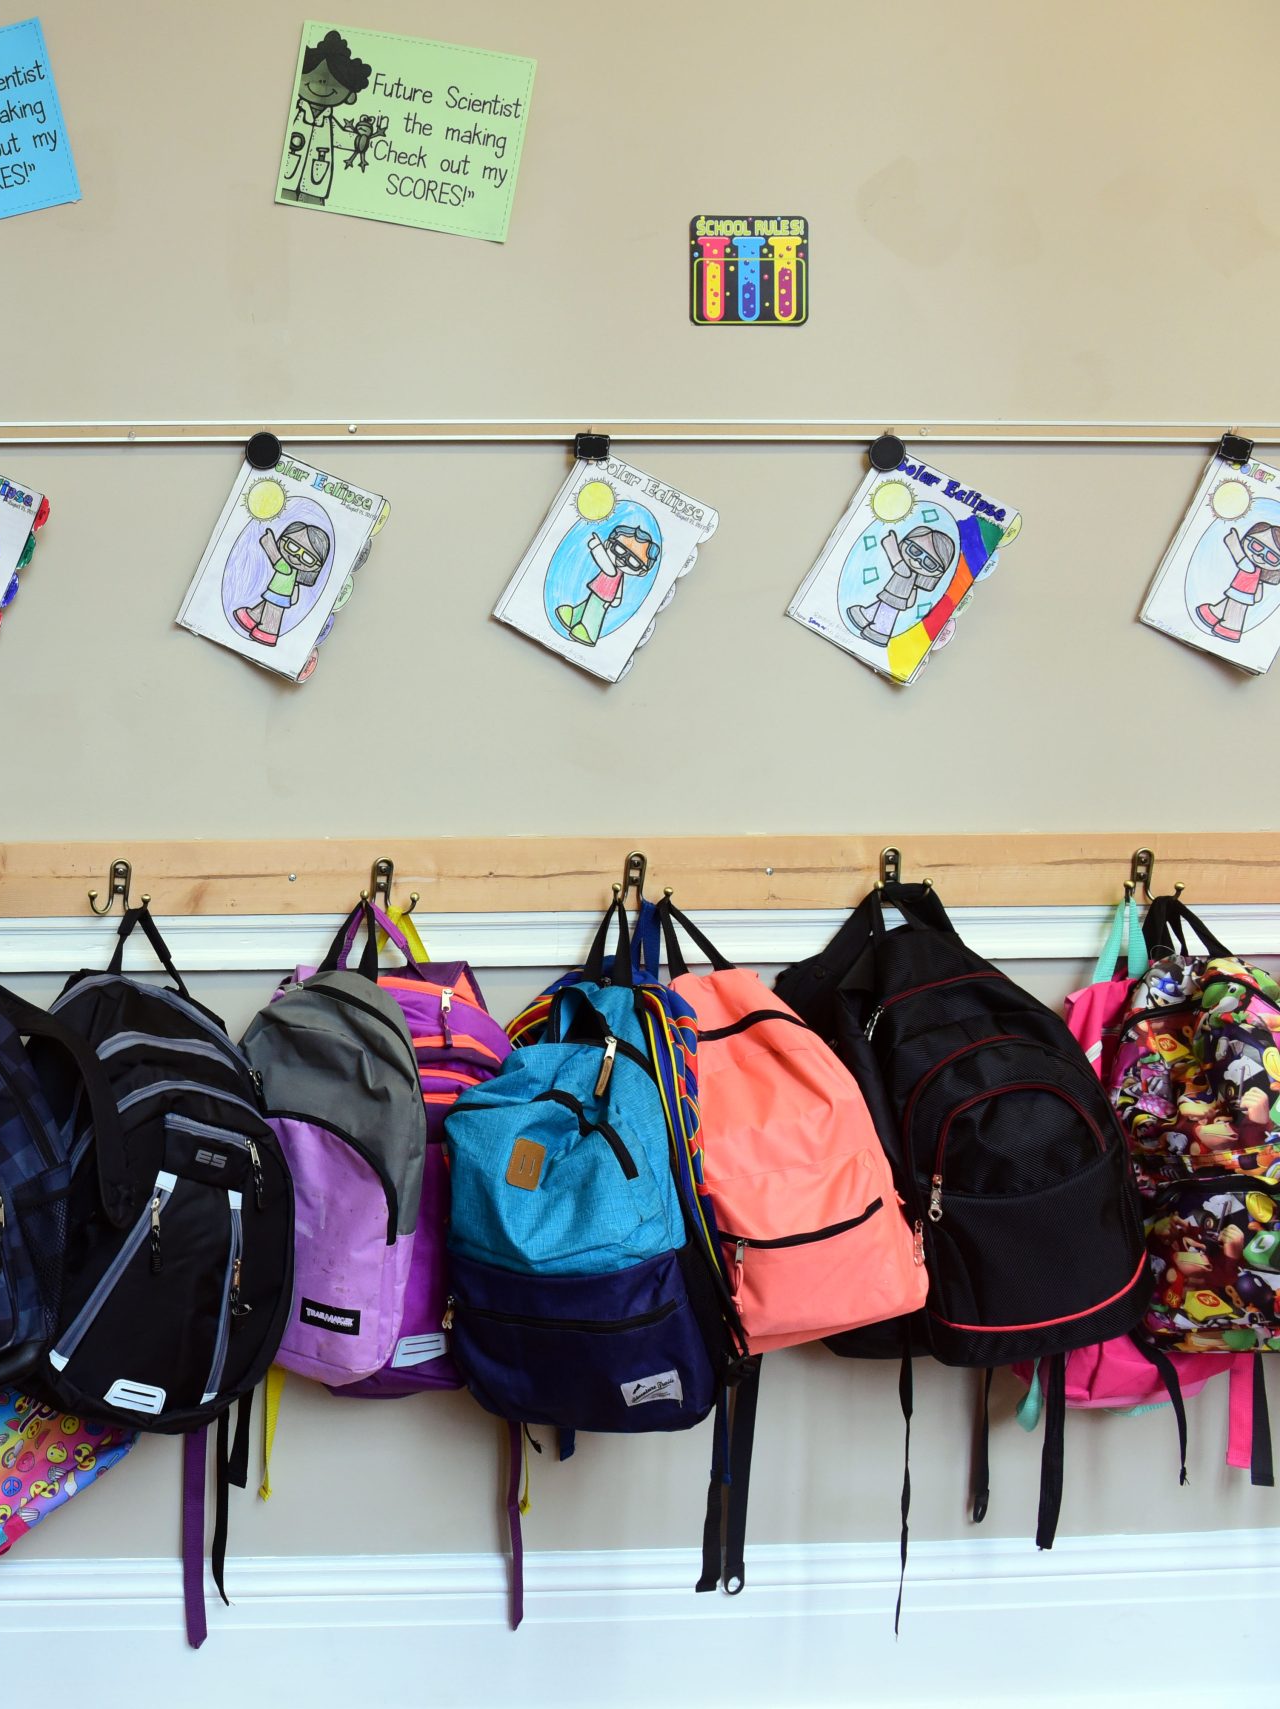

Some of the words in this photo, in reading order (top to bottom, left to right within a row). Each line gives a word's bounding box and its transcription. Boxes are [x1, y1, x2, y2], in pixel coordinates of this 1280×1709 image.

[372, 72, 433, 104] Future
[445, 85, 522, 119] Scientist
[32, 129, 58, 152] my
[403, 112, 433, 137] the
[445, 122, 507, 159] making
[439, 154, 470, 176] out
[482, 165, 508, 189] my
[695, 218, 752, 236] SCHOOL
[754, 218, 805, 236] RULES!
[274, 460, 310, 483] olar
[312, 472, 373, 512] Eclipse
[643, 478, 705, 521] Eclipse
[941, 478, 1006, 523] Eclipse
[195, 1149, 228, 1169] ES
